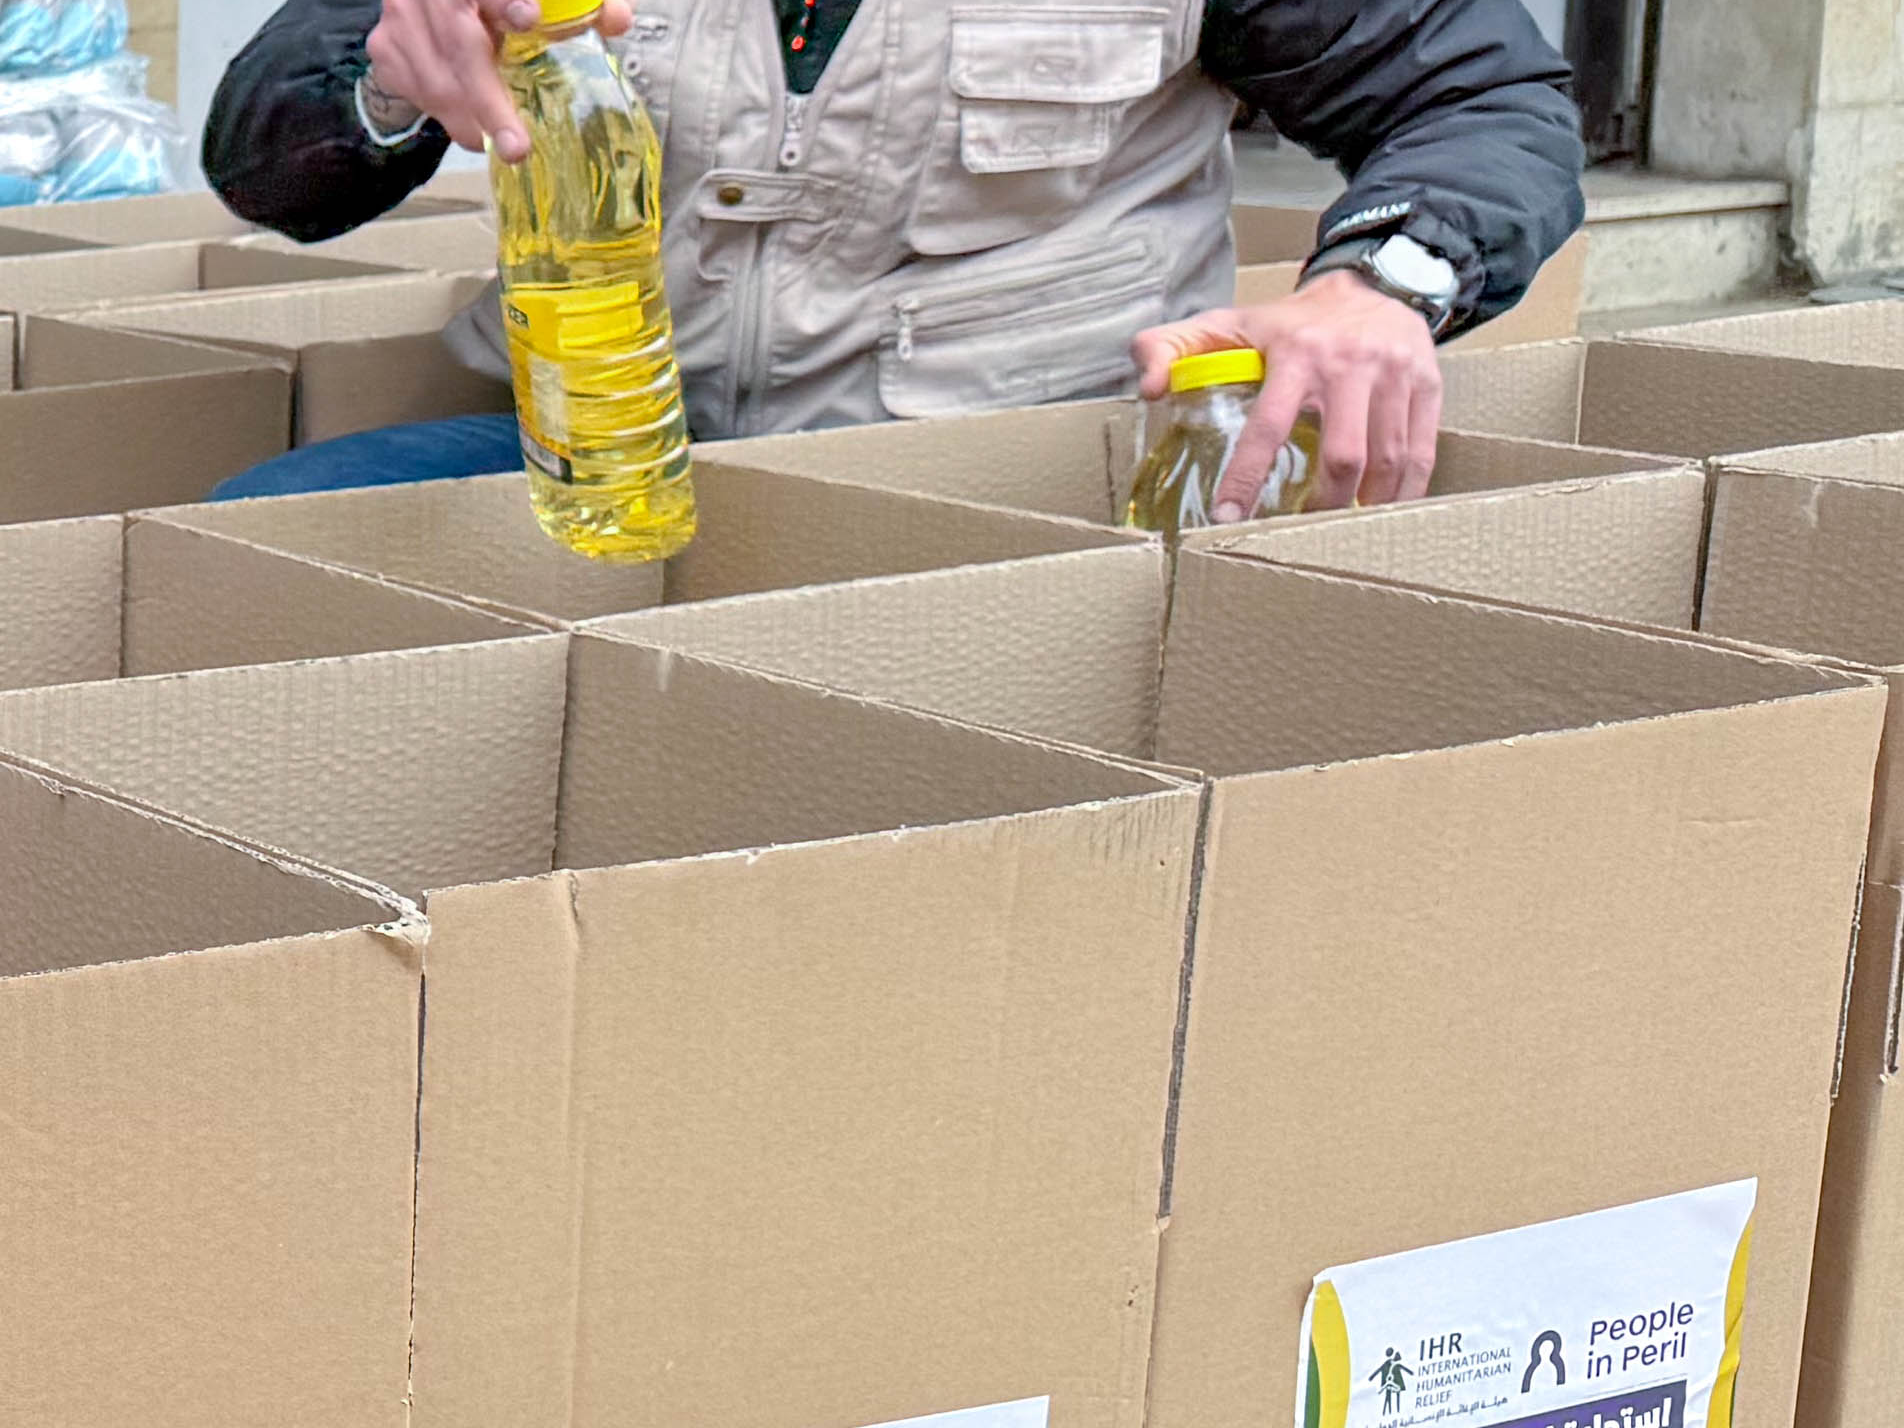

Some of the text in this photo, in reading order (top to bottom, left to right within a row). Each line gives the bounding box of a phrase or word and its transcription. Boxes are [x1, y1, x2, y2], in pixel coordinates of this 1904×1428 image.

[1589, 1301, 1694, 1346] People
[1419, 1332, 1462, 1362] IHR
[1586, 1331, 1687, 1380] in Peril
